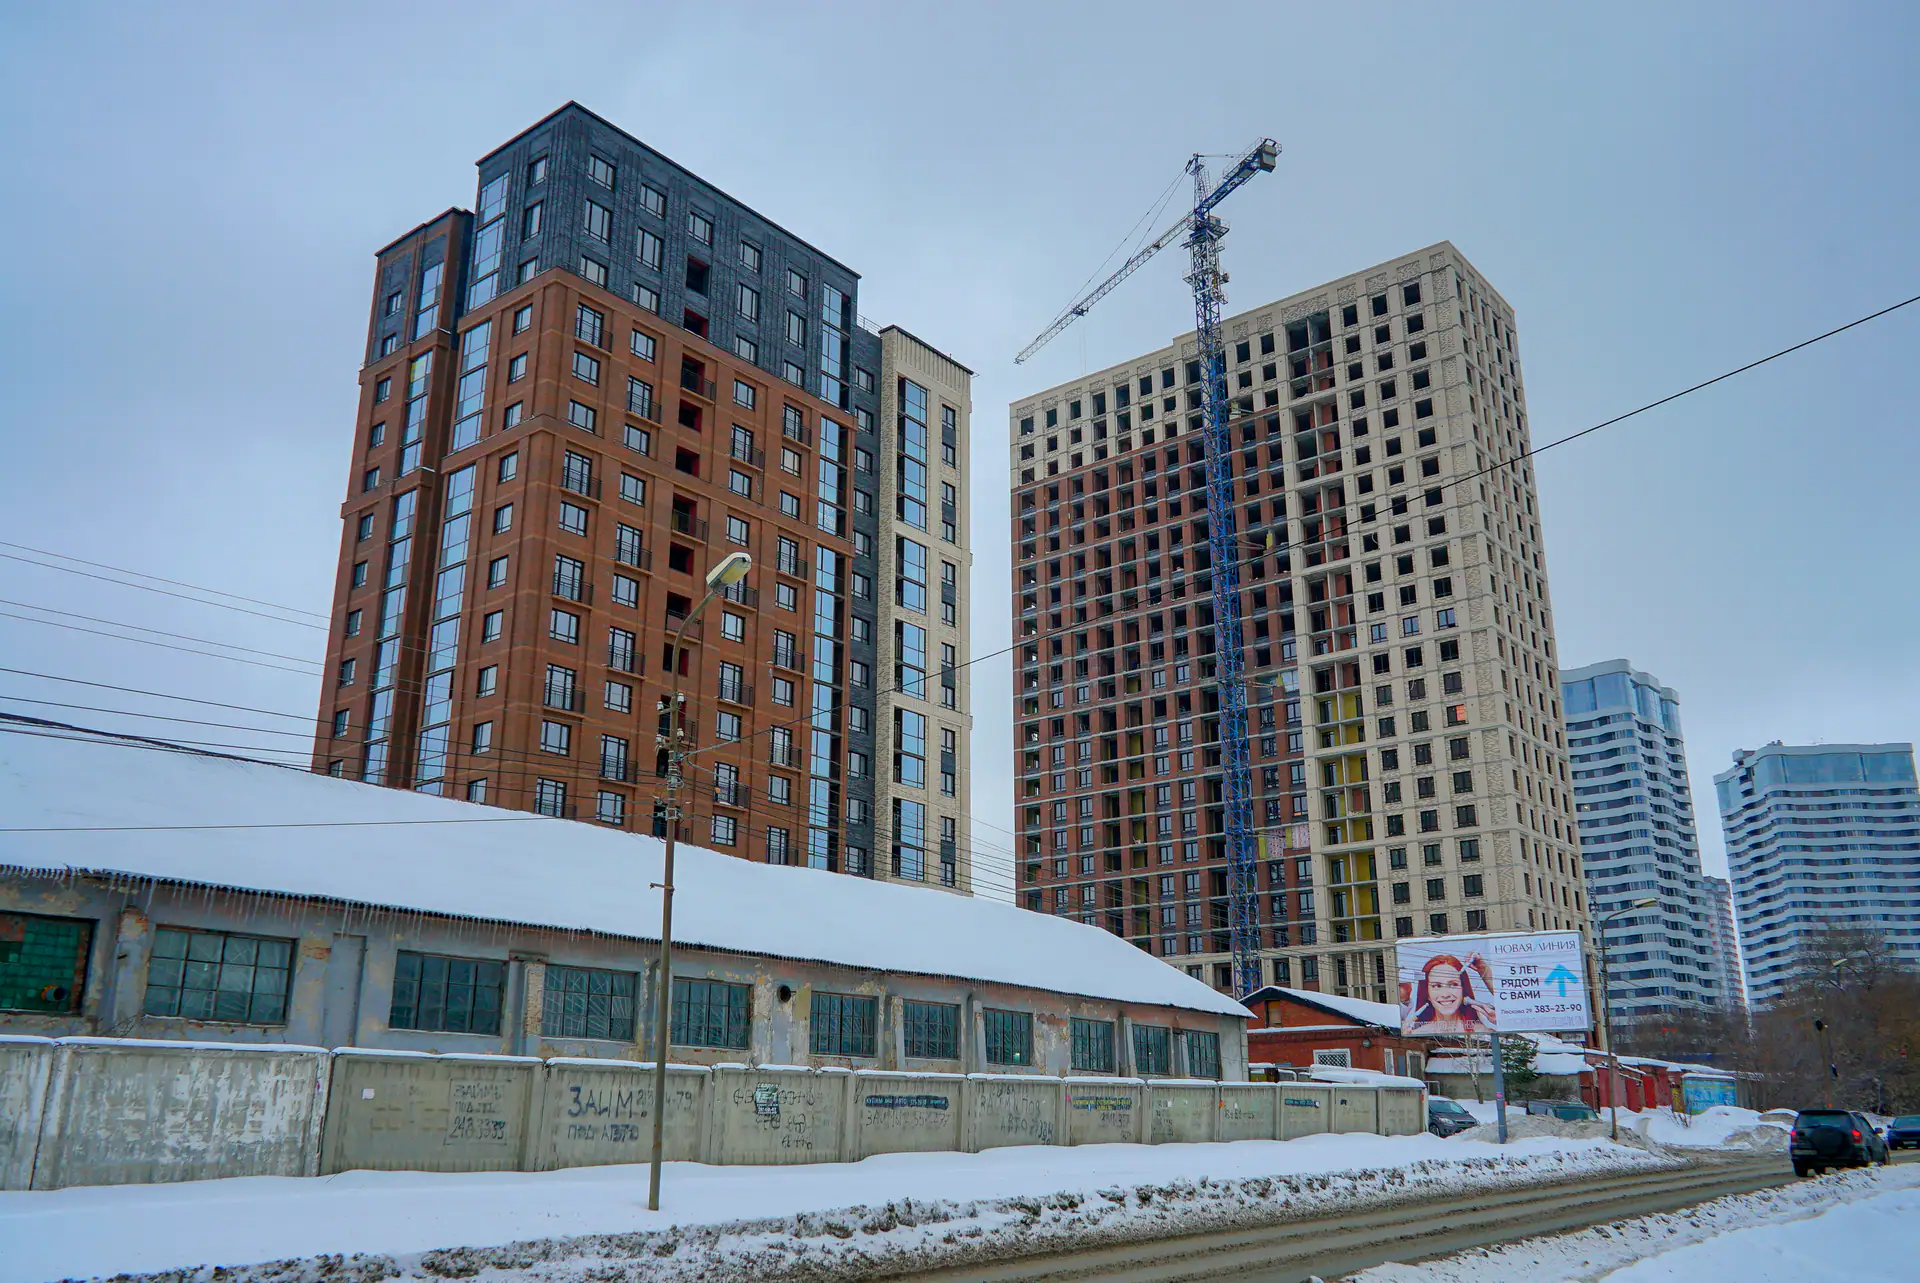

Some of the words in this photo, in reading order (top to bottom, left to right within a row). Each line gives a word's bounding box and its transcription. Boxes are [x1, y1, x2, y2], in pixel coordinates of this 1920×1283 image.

[1494, 943, 1533, 954] НОВАЯ
[1538, 940, 1577, 951] ЛИНИЯ
[1510, 966, 1517, 975] 5
[1518, 965, 1538, 975] ЛЕТ
[1501, 978, 1540, 988] РЯДОМ
[1499, 991, 1508, 1001] С
[1510, 990, 1541, 1000] ВАМИ
[1534, 1003, 1582, 1014] 383-23-90
